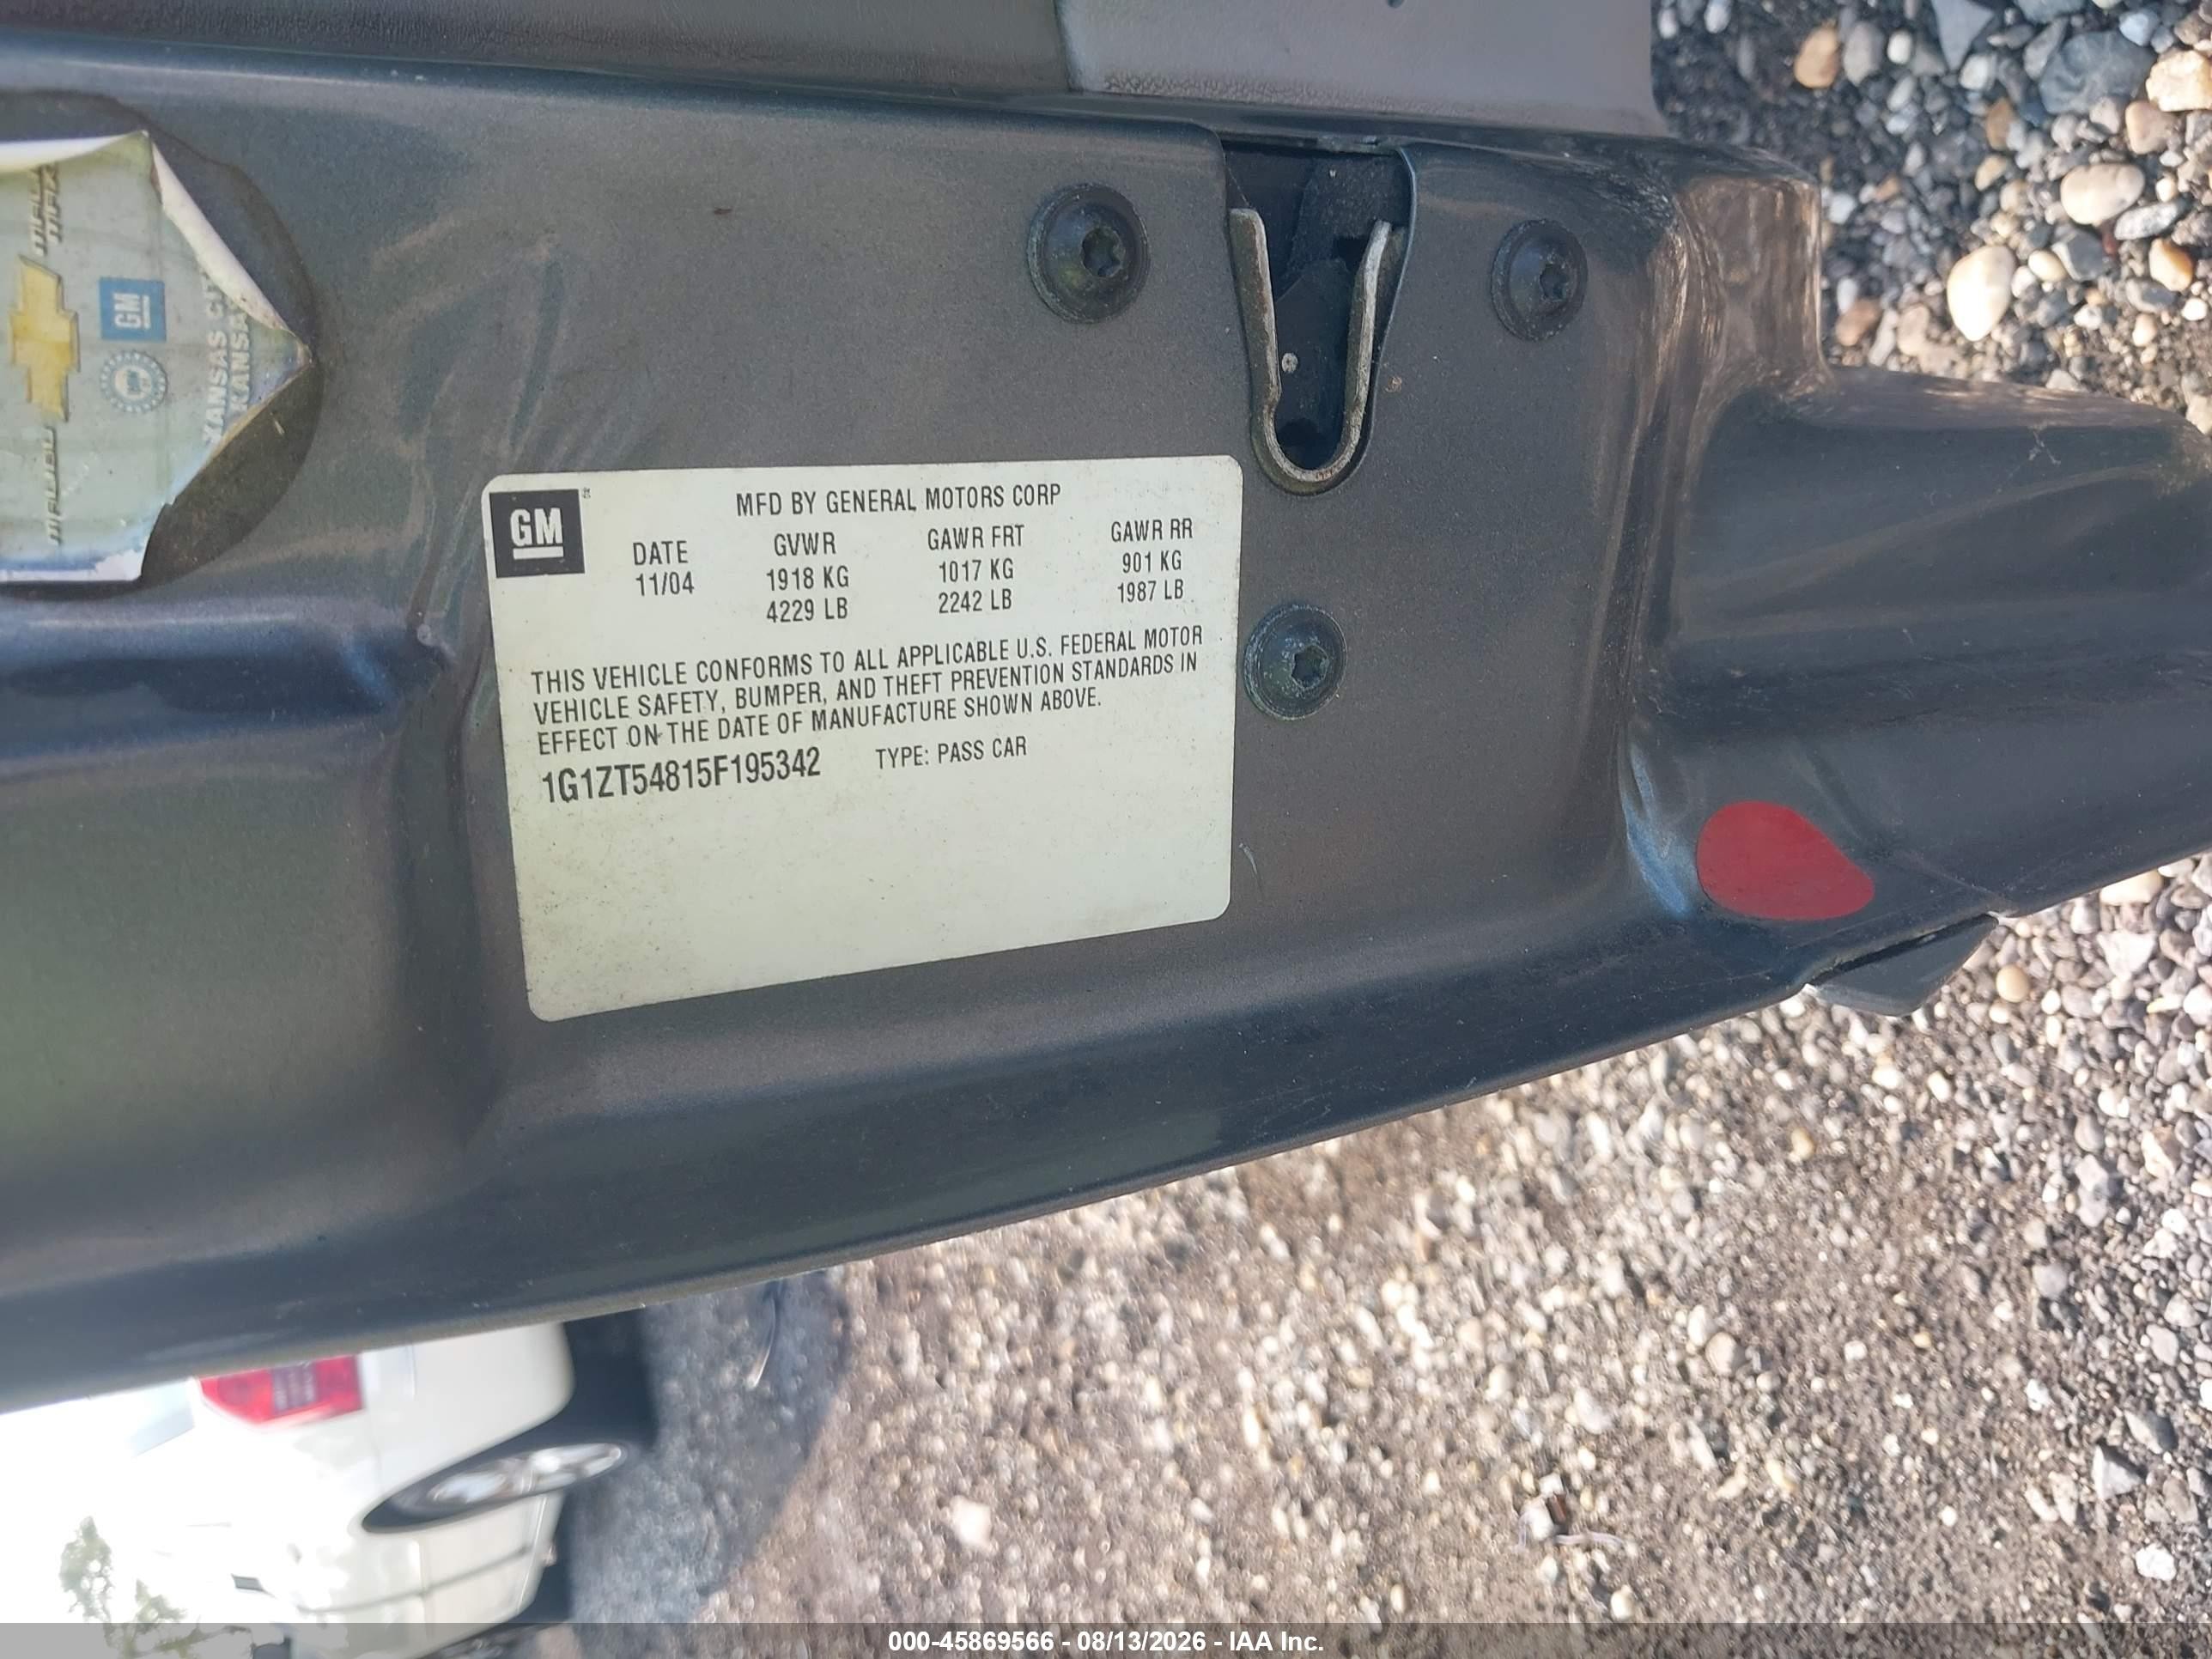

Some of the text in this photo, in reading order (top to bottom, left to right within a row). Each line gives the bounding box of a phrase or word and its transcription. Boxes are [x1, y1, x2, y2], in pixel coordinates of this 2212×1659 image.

[112, 293, 142, 329] GM
[201, 331, 228, 445] KANSAS
[737, 483, 1060, 516] MFD BY GENERAL MOTORS CORP
[510, 507, 563, 546] GM
[928, 525, 1024, 550] GAWR FRT
[1111, 518, 1193, 542] GAWR RR
[633, 540, 688, 566] DATE
[775, 532, 836, 556] GVWR
[939, 557, 1013, 583] 1017 KG
[1123, 550, 1181, 574] 901 KG
[635, 571, 694, 596] 11/04
[767, 565, 848, 591] 1918 KG
[1117, 579, 1183, 603] 1987 LB
[767, 597, 848, 623] 4229 LB
[939, 588, 1012, 614] 2242 LB
[531, 625, 1202, 694] THIS VEHICLE CONFORMS TO ALL APPLICABLE U.S. FEDERAL MOTOR
[533, 652, 1196, 725] VEHICLE SAFETY, BUMPER, AND THEFT PREVENTION STANDARDS IN
[538, 687, 1101, 755] EFFECT ON THE DATE OF MANUFACTURE SHOWN ABOVE.
[875, 736, 1026, 769] TYPE: PASS CAR
[543, 746, 820, 803] 1G1ZT54815F195342
